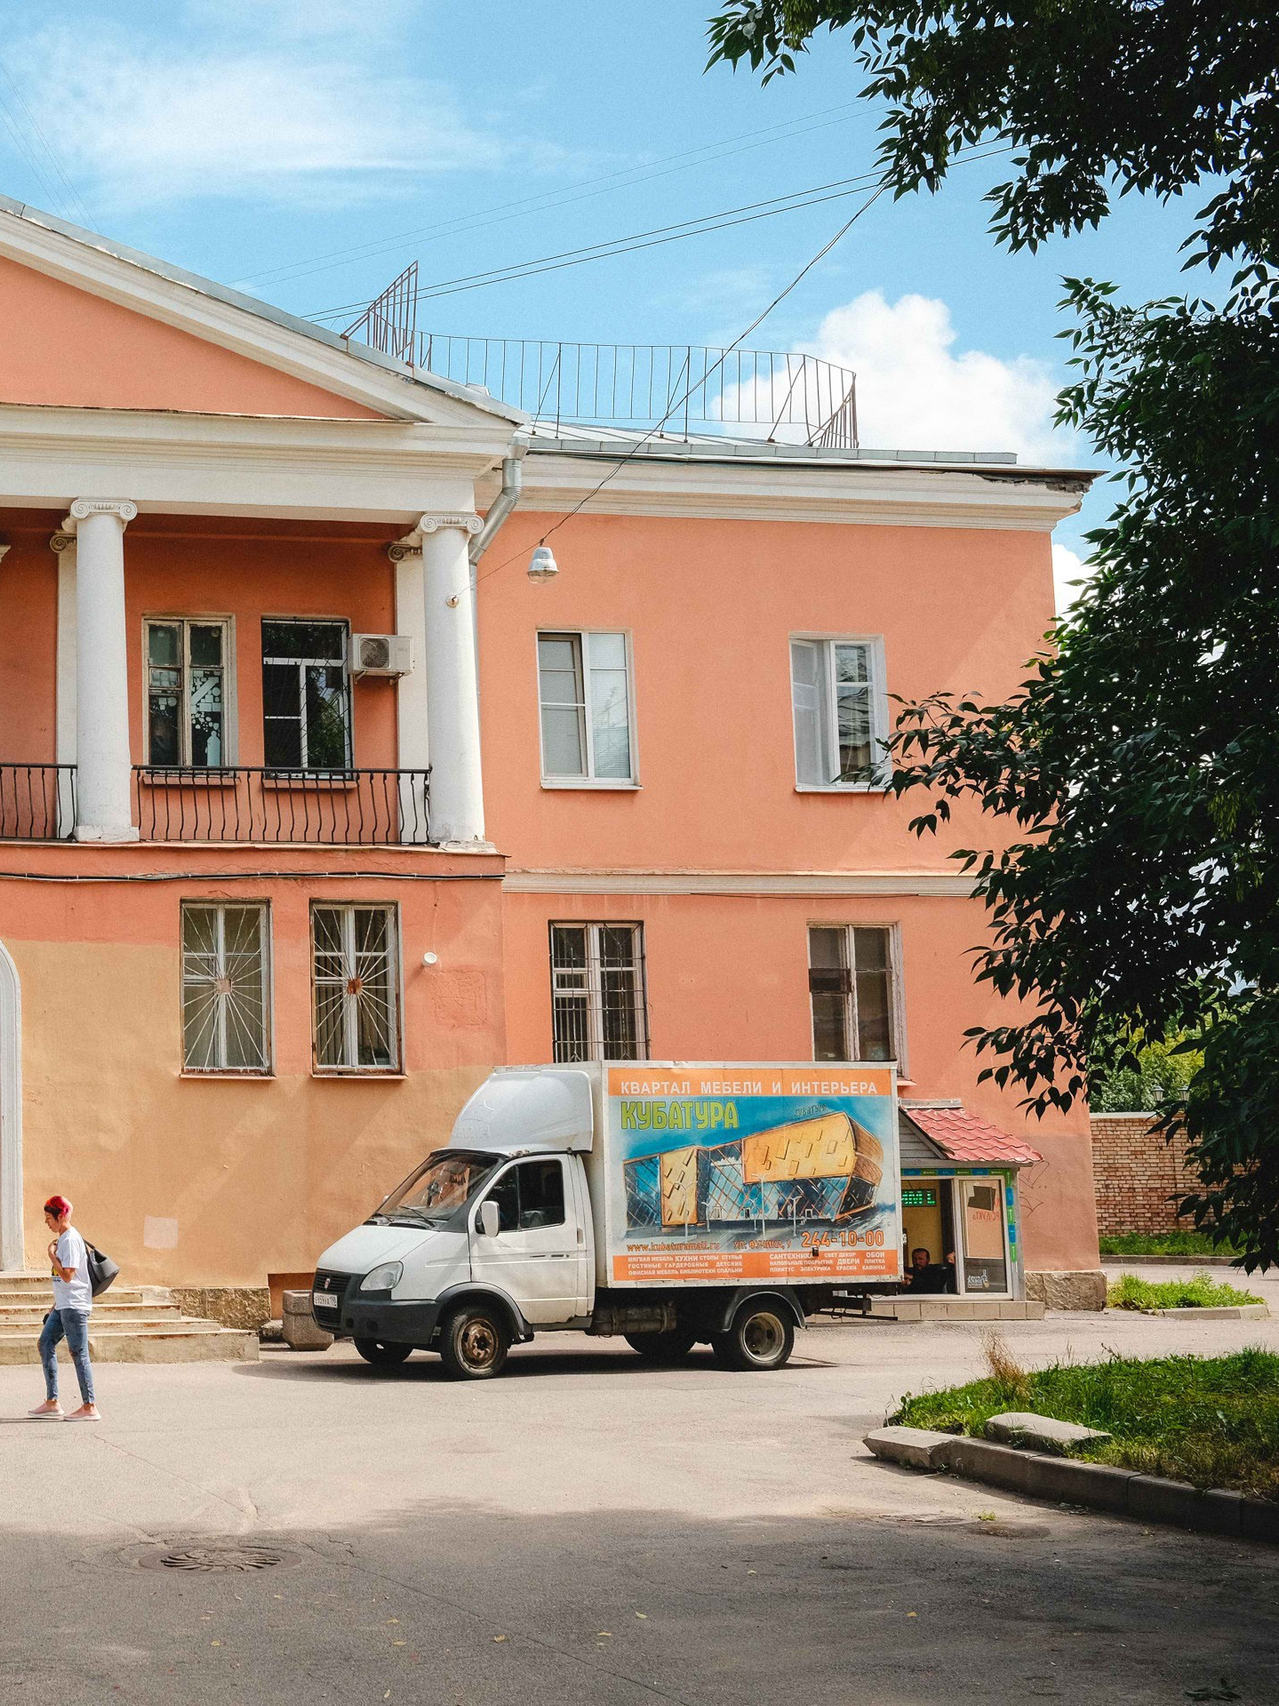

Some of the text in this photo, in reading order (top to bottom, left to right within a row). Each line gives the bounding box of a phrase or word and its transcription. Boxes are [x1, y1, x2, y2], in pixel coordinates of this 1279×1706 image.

[620, 1081, 878, 1095] КВАРТАЛ МЕБЕЛИ И ИНТЕРЬЕРА
[620, 1100, 740, 1130] КУБАТУРА
[801, 1230, 884, 1247] 244-10-00
[627, 1242, 720, 1251] www.kubaturamall.ru
